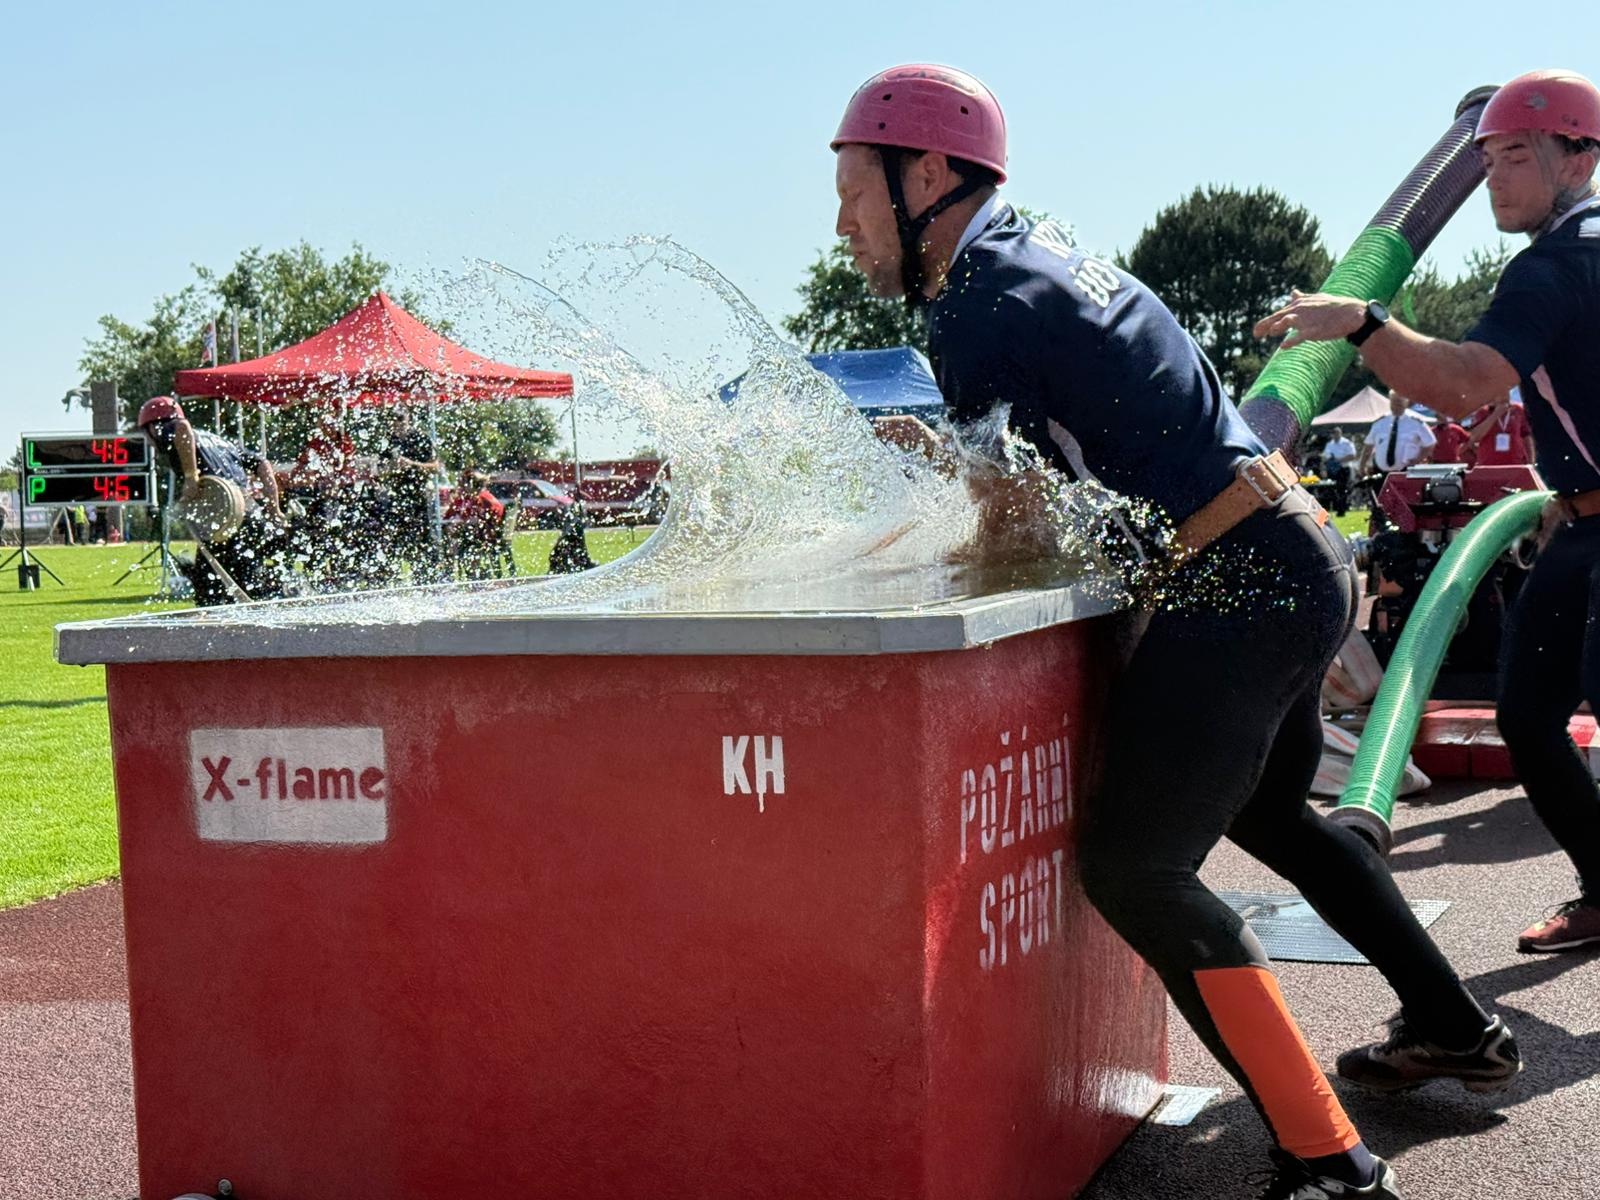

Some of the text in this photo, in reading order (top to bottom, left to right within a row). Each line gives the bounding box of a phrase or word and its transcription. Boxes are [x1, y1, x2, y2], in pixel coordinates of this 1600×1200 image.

[29, 440, 43, 468] L
[30, 476, 46, 502] P
[201, 755, 386, 802] X-flame
[722, 735, 785, 796] KH
[978, 848, 1064, 971] SPORT
